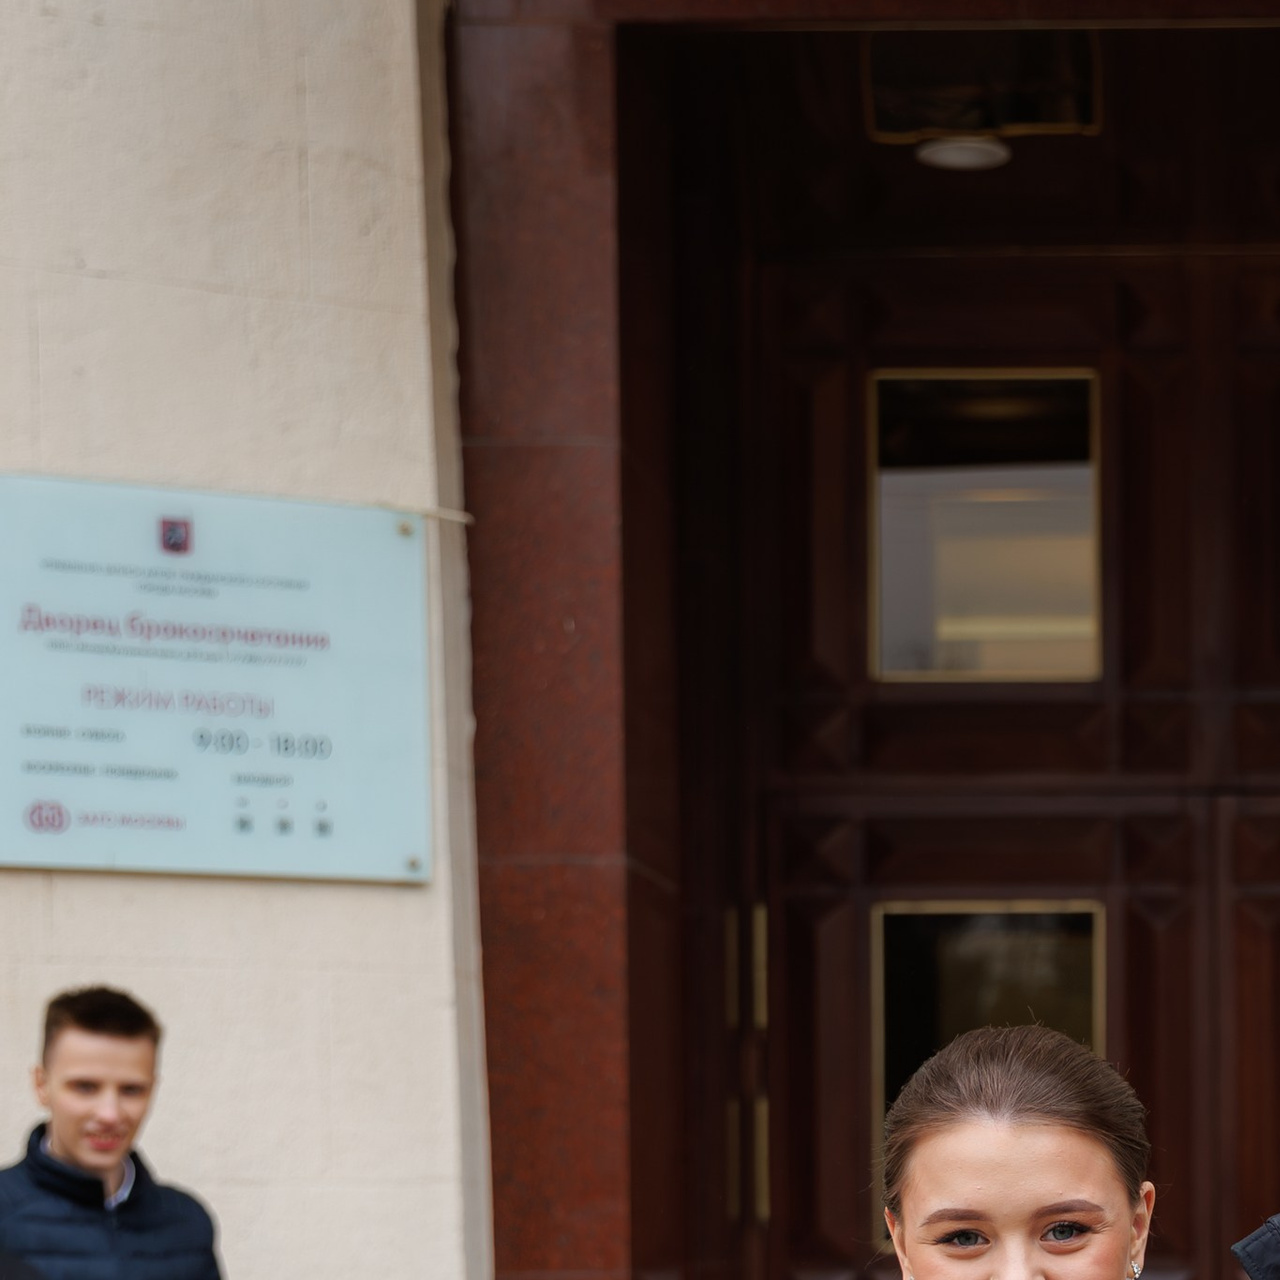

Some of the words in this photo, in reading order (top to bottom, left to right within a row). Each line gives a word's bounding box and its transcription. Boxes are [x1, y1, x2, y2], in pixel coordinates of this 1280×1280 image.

[20, 603, 120, 637] Дворец
[82, 685, 176, 711] РЕЖИМ
[181, 691, 275, 718] РАБОТЫ
[268, 732, 332, 759] 18:00
